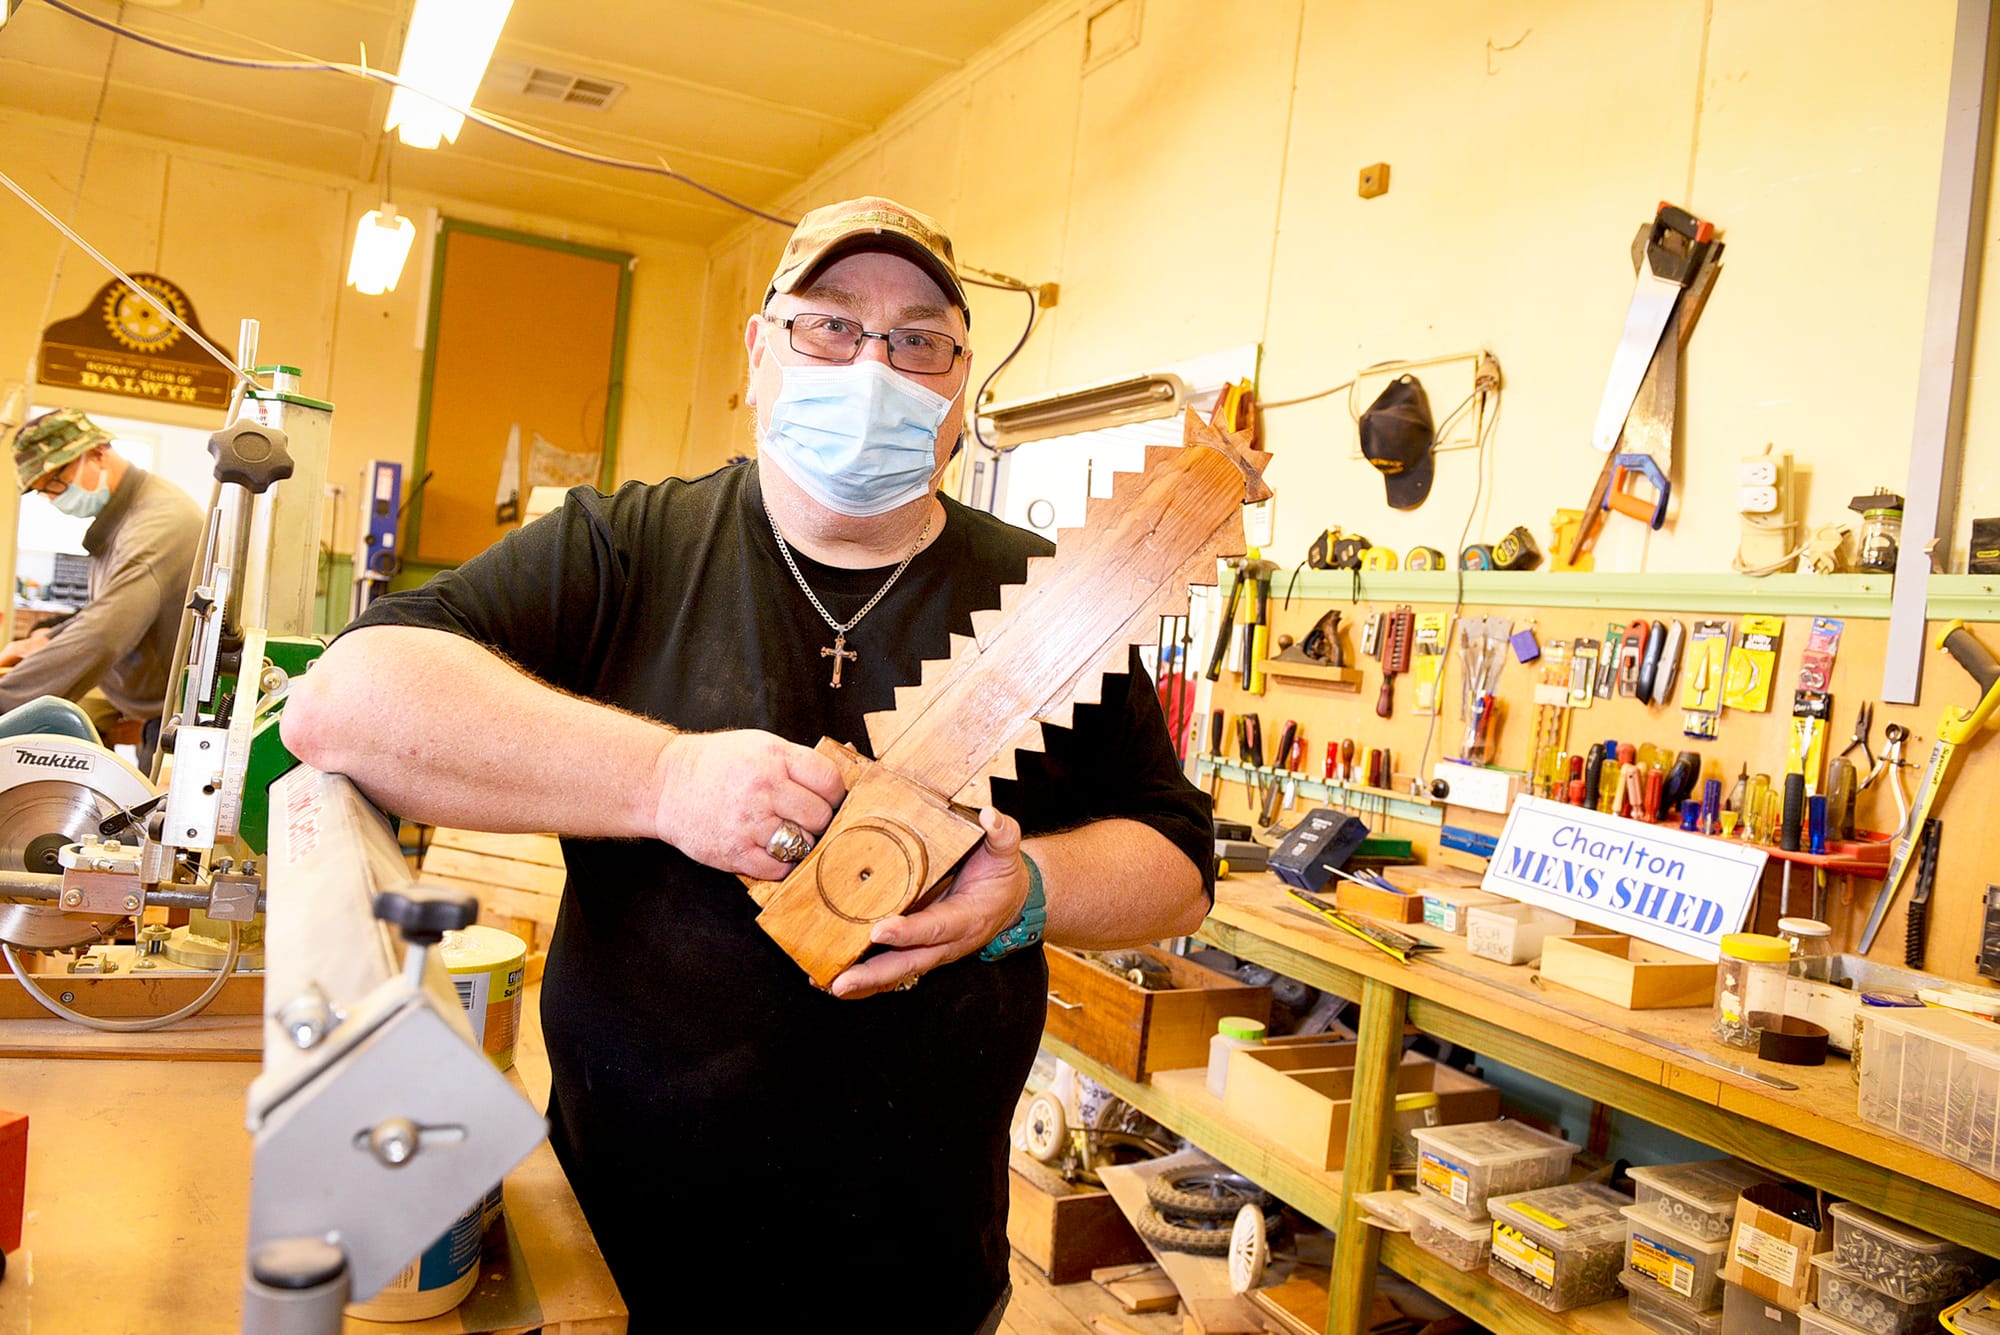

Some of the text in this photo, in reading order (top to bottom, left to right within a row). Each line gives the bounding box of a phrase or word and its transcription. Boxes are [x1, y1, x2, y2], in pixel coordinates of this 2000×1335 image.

[80, 371, 198, 401] BALWYN
[1551, 824, 1686, 881] Charlton
[1503, 846, 1724, 936] MENS SHED
